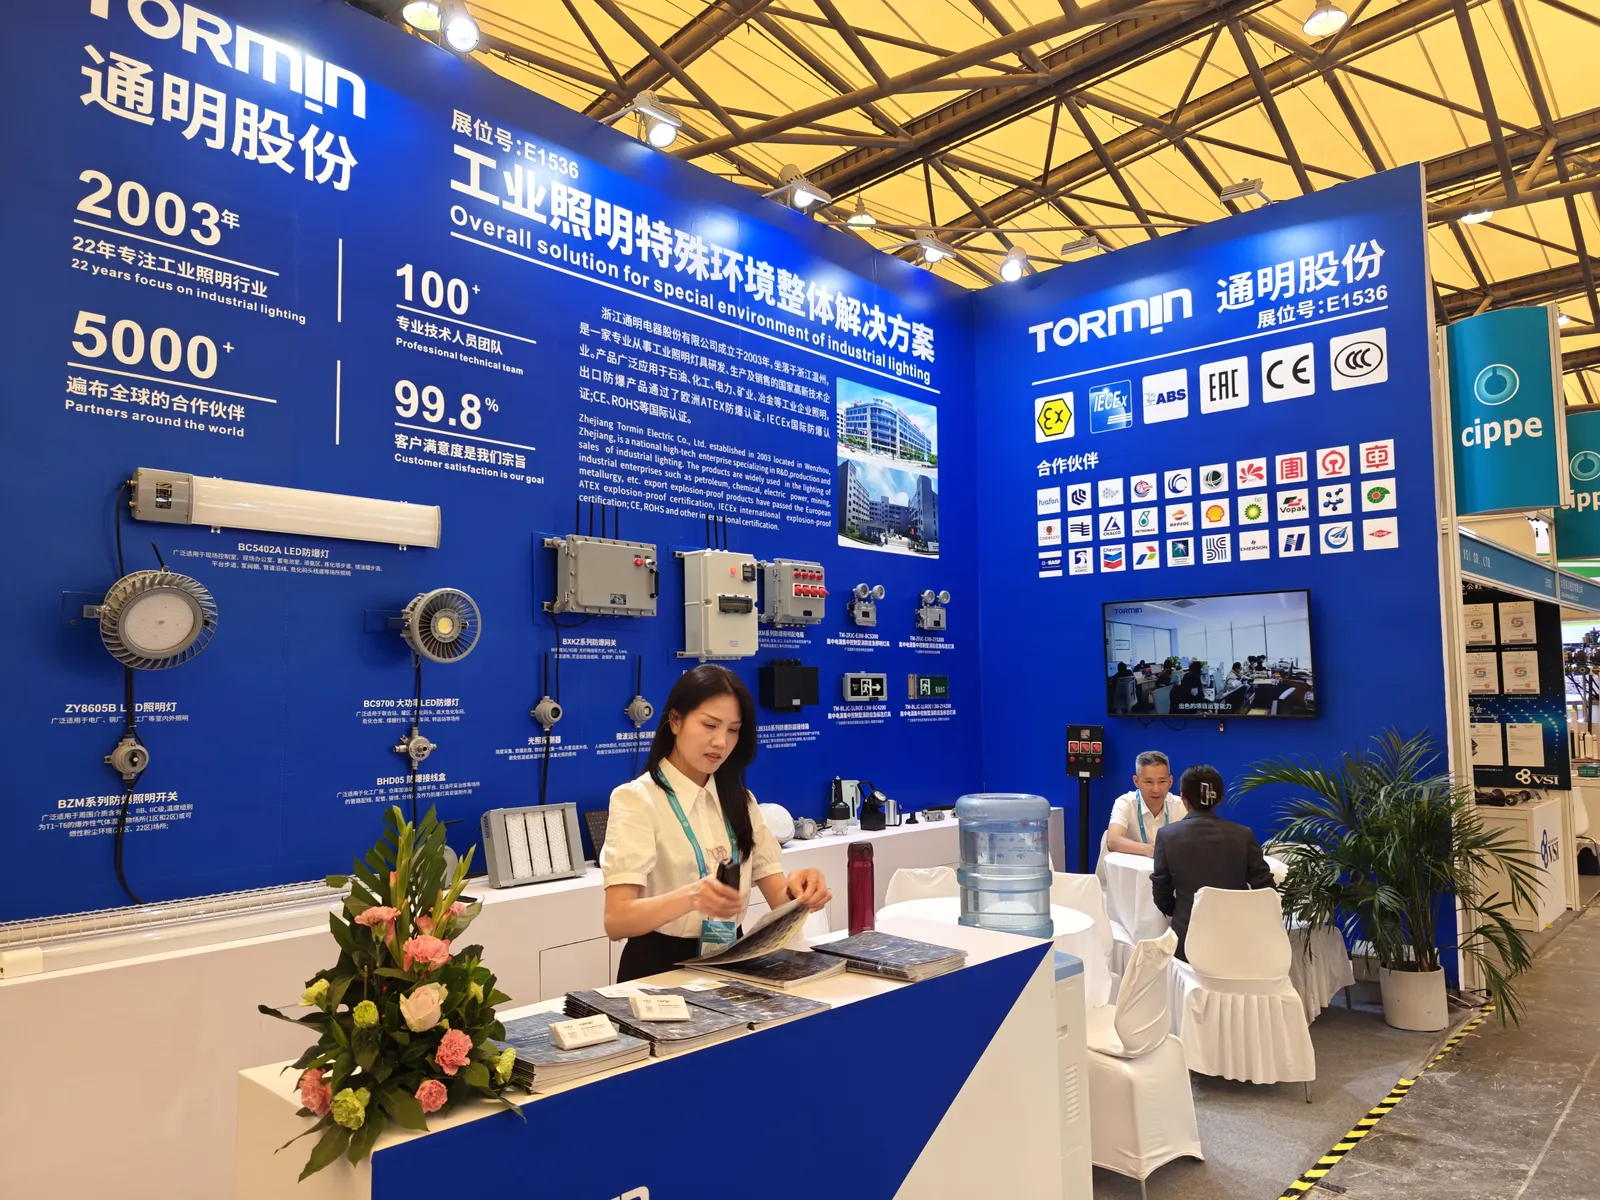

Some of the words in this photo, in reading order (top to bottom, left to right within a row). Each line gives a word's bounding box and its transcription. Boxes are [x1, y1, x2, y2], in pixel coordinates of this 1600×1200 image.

[80, 44, 358, 191] 通明股份
[451, 108, 579, 179] 展位号:E1536
[72, 235, 268, 298] 22年专注工业照明行业
[450, 143, 935, 363] 工业照明特殊环境整体解决方案
[71, 257, 89, 271] 22
[92, 262, 132, 281] years
[134, 272, 174, 291] focus
[176, 283, 194, 296] on
[196, 288, 258, 312] industrial
[260, 303, 307, 325] lighting
[450, 205, 531, 250] Overall
[537, 238, 619, 279] solution
[623, 264, 650, 288] for
[653, 278, 714, 310] special
[717, 298, 809, 343] environment
[812, 331, 826, 350] of
[828, 335, 886, 368] industrial
[888, 356, 931, 386] lighting
[1216, 238, 1386, 314] 通明股份
[1028, 288, 1193, 353] TORMIN
[1257, 284, 1388, 329] 展位号:E1536
[395, 315, 504, 357] 专业技术人员团队
[396, 337, 458, 360] Professional
[459, 352, 501, 370] technical
[502, 363, 524, 376] team
[1209, 368, 1239, 402] EAC
[1266, 354, 1310, 389] CE
[65, 374, 246, 422] 遍布全球的合作伙伴
[394, 379, 499, 431] 99.8%
[1093, 390, 1128, 413] IECEx
[1155, 388, 1186, 405] ABS
[64, 399, 129, 419] Partners
[131, 409, 181, 428] around
[184, 419, 206, 432] the
[208, 424, 245, 438] world
[1461, 416, 1543, 449] cippe
[394, 433, 526, 470] 客户满意度是我们宗旨
[578, 413, 614, 431] Zhejiang
[616, 421, 644, 435] Tormin
[646, 428, 674, 442] Electric
[677, 435, 691, 446] Co.,
[693, 438, 707, 449] Ltd.
[709, 442, 746, 457] established
[748, 450, 755, 458] in
[757, 452, 771, 462] 2003
[773, 455, 795, 467] located
[796, 460, 803, 469] in
[804, 462, 831, 475] Wenzhou,
[578, 426, 616, 444] Zhejiang,
[617, 434, 624, 444] is
[625, 437, 630, 445] a
[631, 438, 662, 451] national
[663, 443, 696, 458] high-tech
[698, 451, 735, 465] enterprise
[733, 459, 769, 474] specializing
[770, 465, 776, 473] in
[820, 478, 831, 486] and
[1036, 451, 1099, 477] 合作伙伴
[394, 453, 443, 469] Customer
[444, 460, 499, 478] satisfaction
[500, 468, 508, 478] is
[509, 472, 525, 481] our
[526, 474, 545, 485] goal
[578, 441, 600, 452] sales
[605, 445, 614, 454] of
[616, 447, 653, 462] industrial
[655, 455, 685, 469] lighting.
[687, 461, 700, 471] The
[701, 465, 731, 477] products
[732, 471, 743, 479] are
[745, 473, 765, 485] widely
[766, 477, 781, 486] used
[784, 480, 791, 488] in
[791, 481, 801, 490] the
[803, 484, 824, 496] lighting
[825, 488, 831, 496] of
[578, 453, 617, 467] industrial
[620, 461, 662, 477] enterprises
[664, 469, 682, 480] such
[684, 474, 692, 482] as
[694, 476, 731, 489] petroleum,
[732, 482, 762, 495] chemical,
[763, 487, 786, 498] electric
[790, 493, 810, 504] power,
[810, 496, 831, 508] mining,
[578, 467, 625, 484] metallurgy,
[626, 476, 641, 485] etc.
[643, 479, 668, 489] export
[670, 483, 724, 498] explosion-proof
[726, 492, 754, 504] products
[755, 497, 771, 507] have
[772, 500, 792, 511] passed
[794, 503, 804, 513] the
[805, 506, 831, 517] European
[578, 480, 600, 491] ATEX
[603, 483, 667, 500] explosion-proof
[669, 495, 716, 510] certification,
[718, 502, 737, 513] IECEx
[739, 506, 781, 520] international
[786, 514, 831, 527] explosion-proof
[578, 494, 630, 510] certification;
[630, 500, 643, 511] CE,
[643, 503, 665, 514] ROHS
[665, 506, 679, 516] and
[679, 508, 698, 518] other
[741, 518, 780, 531] certification.
[1279, 505, 1307, 514] Vopak
[238, 542, 282, 555] BC5402A
[284, 547, 330, 559] LED防爆灯
[64, 703, 117, 714] ZY8605B
[120, 701, 178, 713] LD照明灯
[363, 699, 395, 708] BC9700
[376, 775, 405, 786] BHD05
[1531, 776, 1559, 785] VSI
